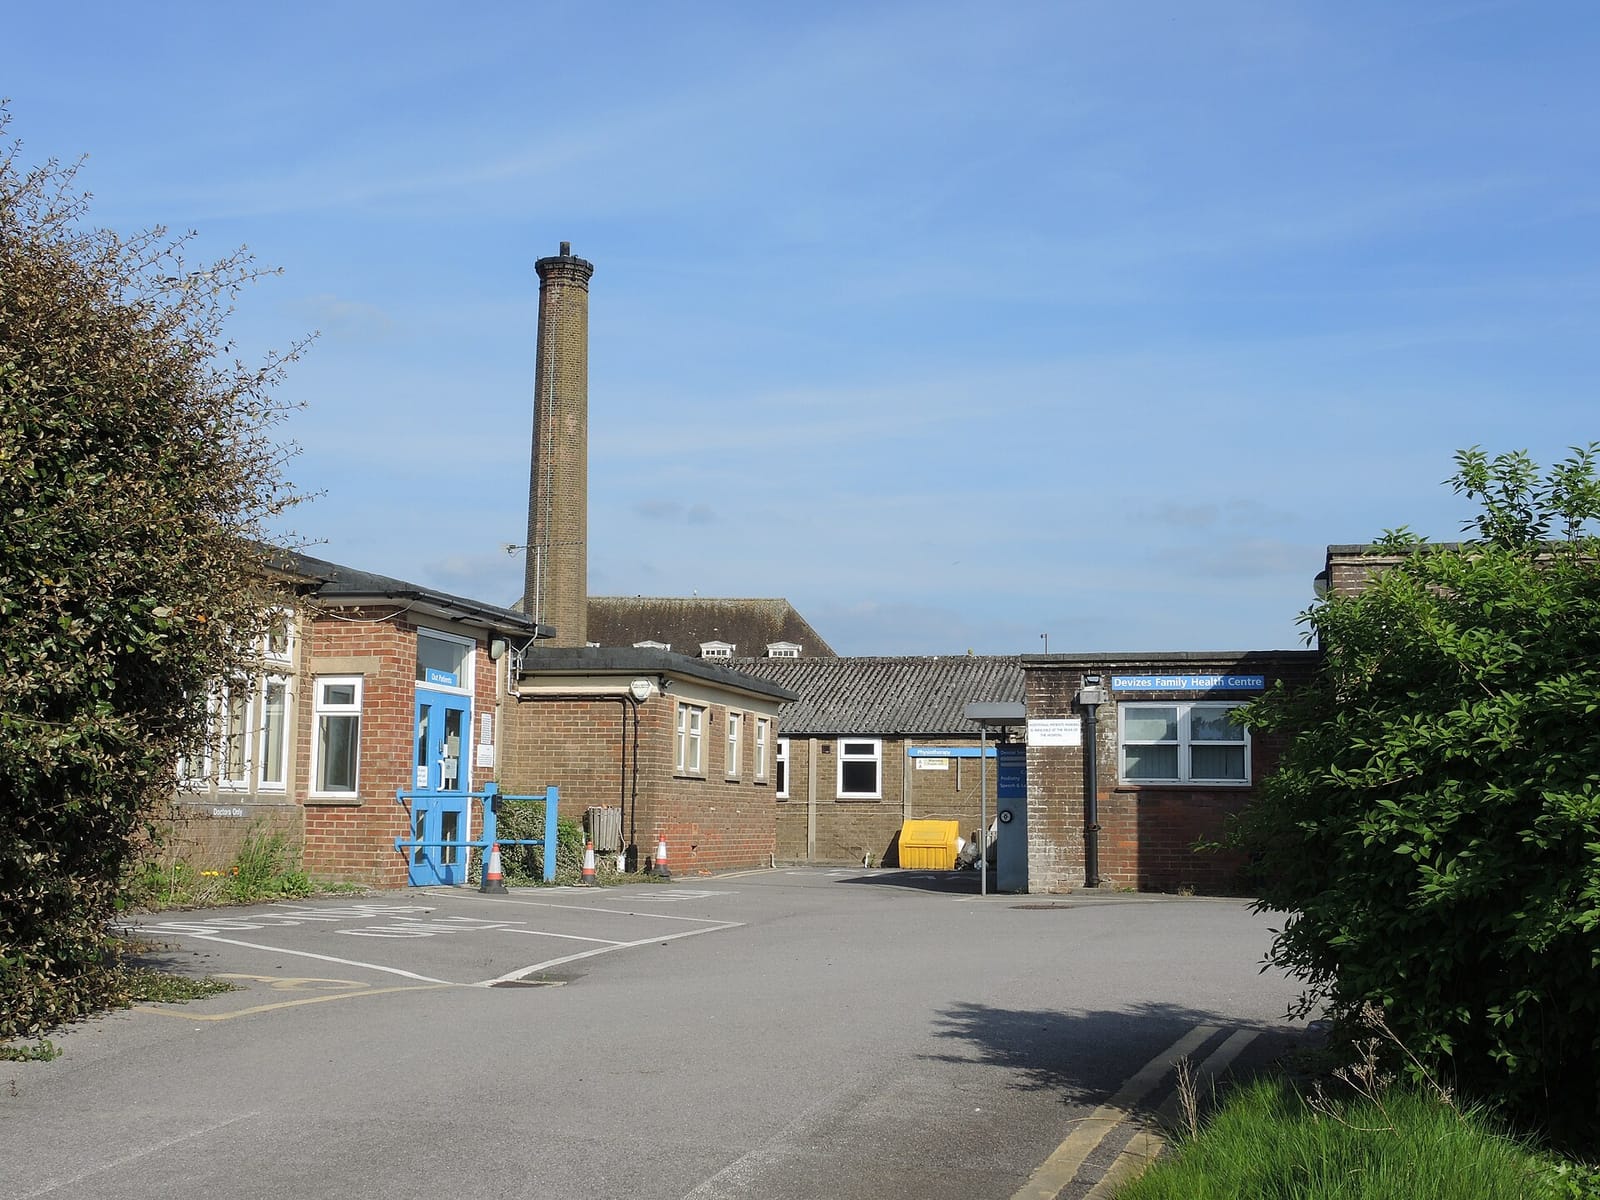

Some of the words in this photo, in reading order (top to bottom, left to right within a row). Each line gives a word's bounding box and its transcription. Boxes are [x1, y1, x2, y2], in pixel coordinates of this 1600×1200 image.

[1114, 677, 1152, 687] Devizes
[1155, 677, 1187, 689] Family
[1191, 676, 1224, 687] Health
[1228, 677, 1262, 687] Centre
[213, 807, 231, 816] Doctors
[232, 808, 243, 817] Only
